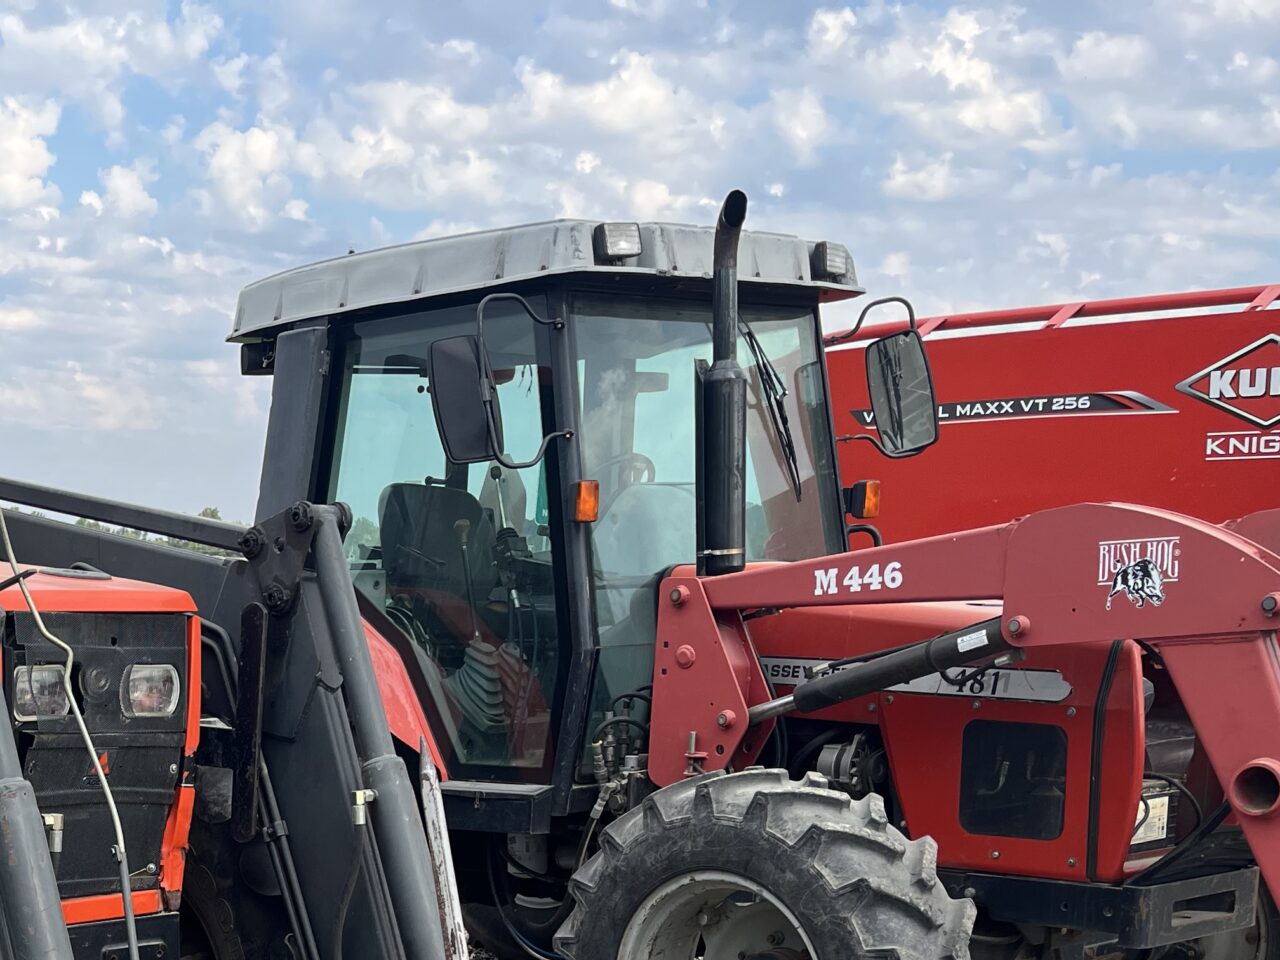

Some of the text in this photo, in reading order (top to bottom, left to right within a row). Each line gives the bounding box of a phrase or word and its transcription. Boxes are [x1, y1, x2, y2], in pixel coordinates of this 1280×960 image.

[956, 400, 1015, 417] MAXX
[1020, 398, 1047, 412] VT
[1052, 396, 1091, 411] 256
[814, 561, 903, 596] M 446
[1098, 542, 1141, 582] BUSH
